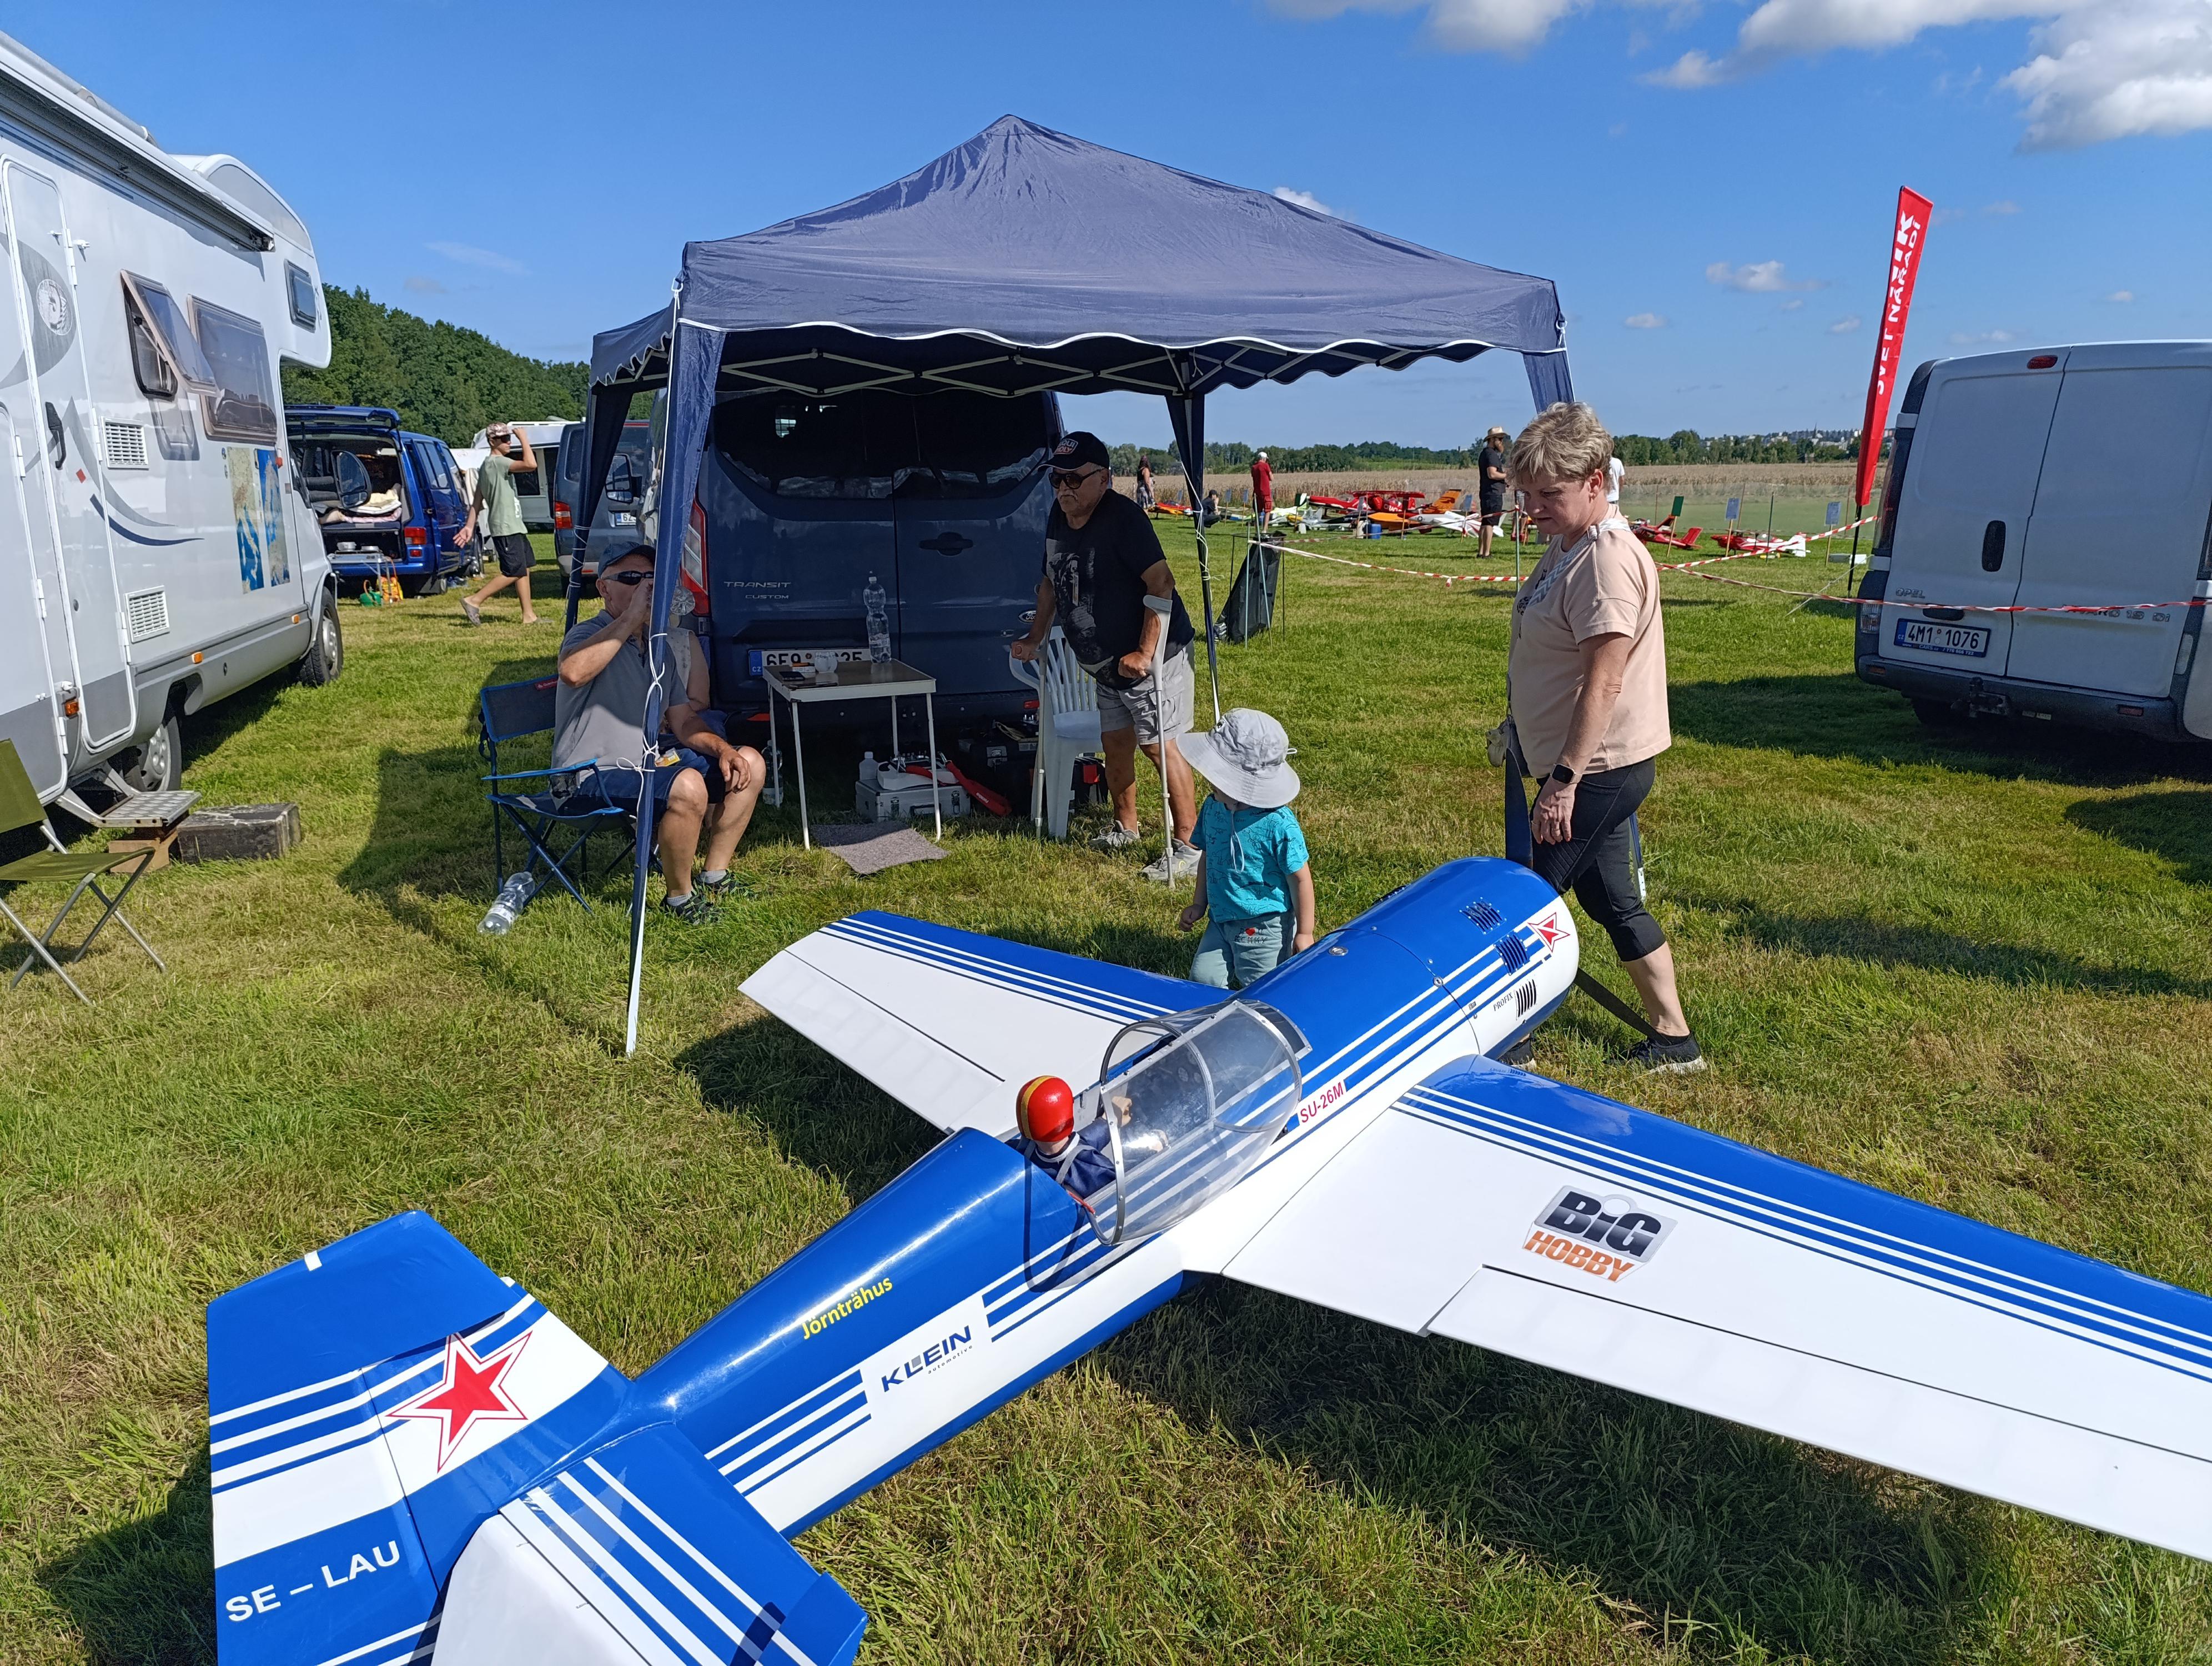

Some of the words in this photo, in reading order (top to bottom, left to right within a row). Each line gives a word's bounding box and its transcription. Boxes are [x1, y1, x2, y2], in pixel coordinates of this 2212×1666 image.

[1896, 588, 1926, 599] OPEL
[1908, 625, 1933, 643] 4M1
[1945, 629, 1980, 649] 1076
[1493, 992, 1513, 1011] PROFIX
[1300, 1082, 1344, 1123] SU-26M
[1524, 1230, 1635, 1282] HOBBY
[802, 1278, 893, 1339] Jörnträhus
[881, 1326, 972, 1392] KLEIN
[928, 1345, 972, 1374] automotive
[226, 1584, 281, 1622] SE
[321, 1540, 401, 1589] LAU
